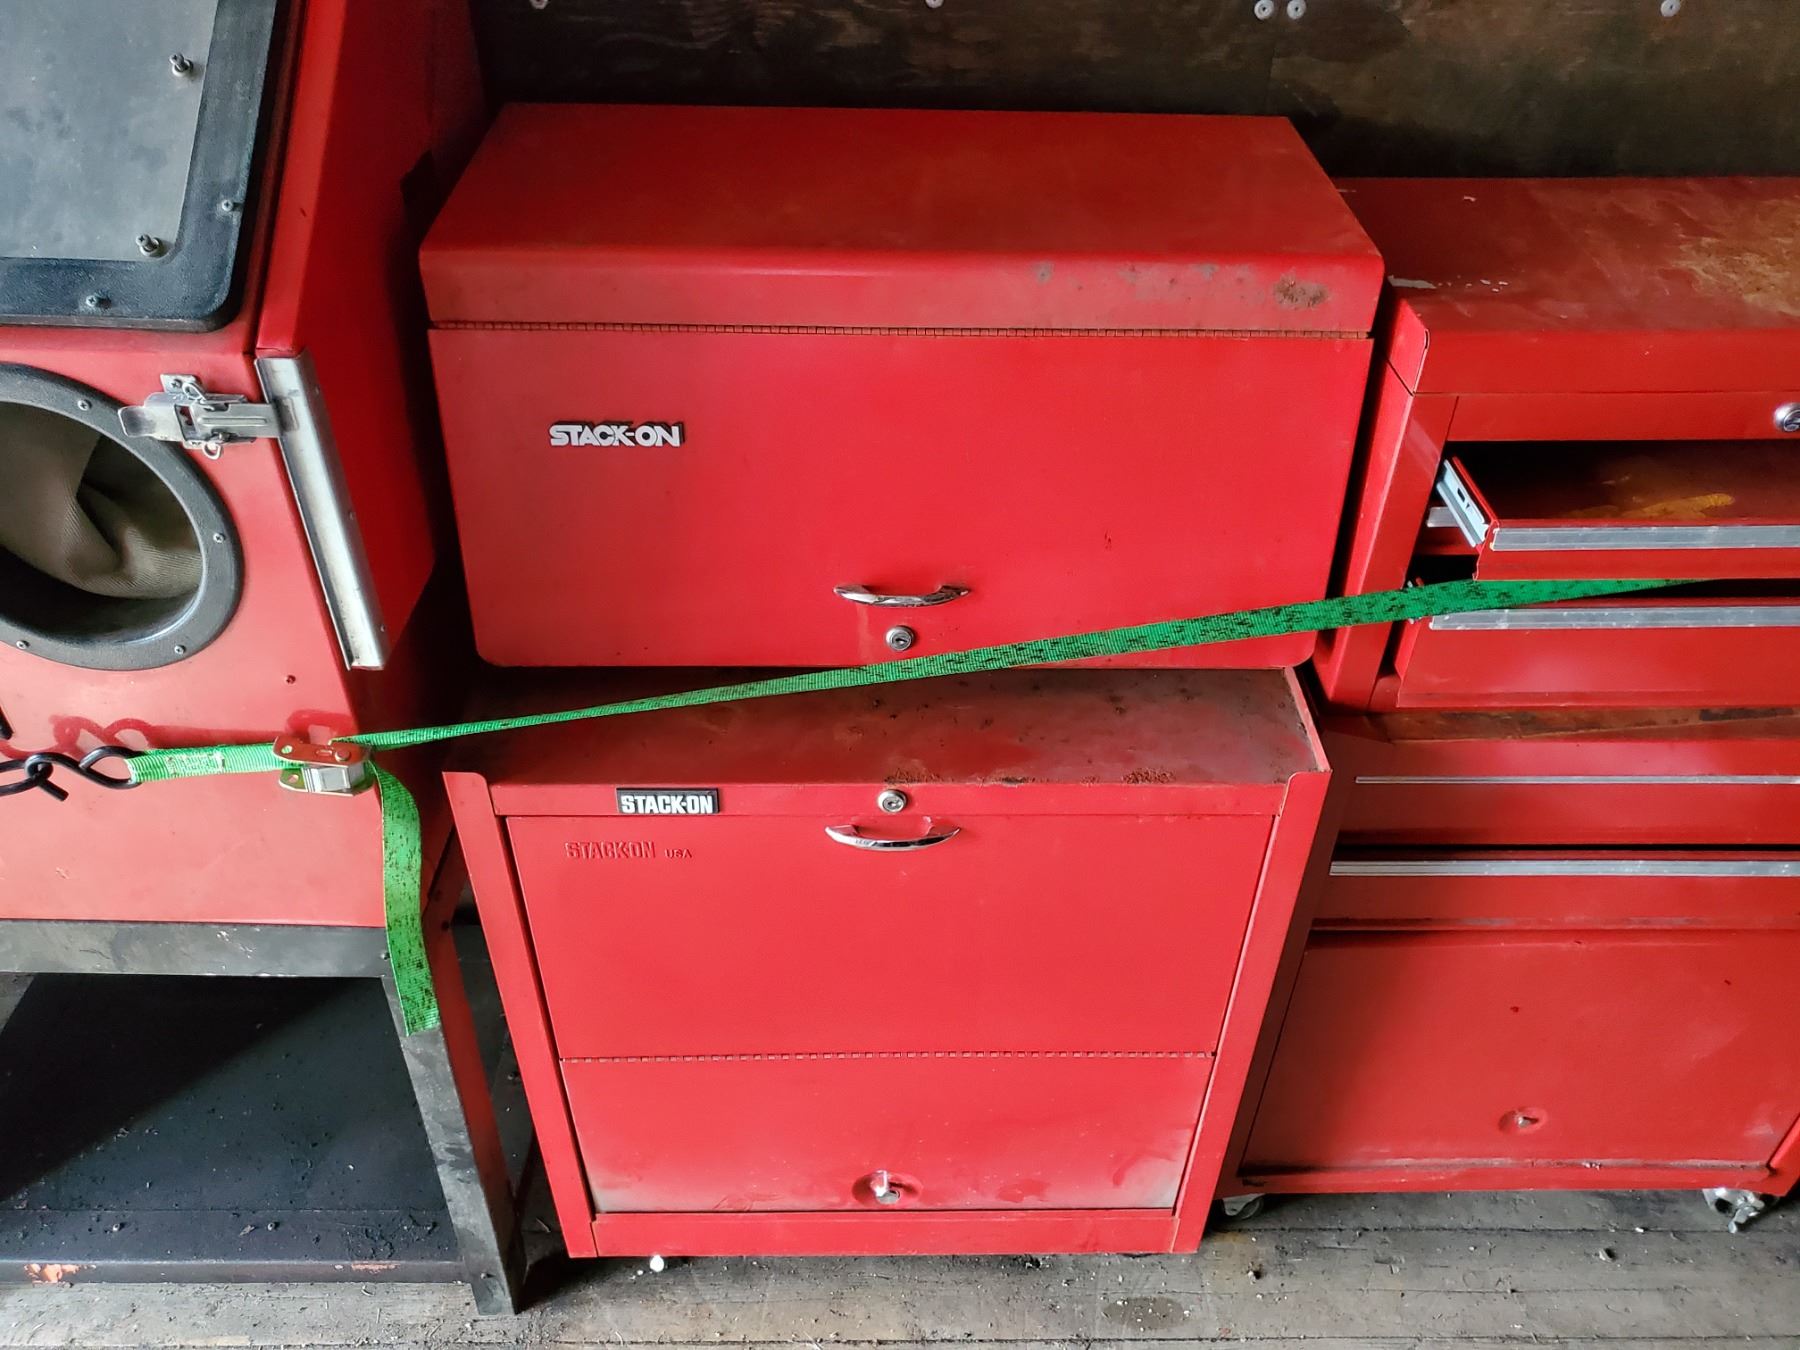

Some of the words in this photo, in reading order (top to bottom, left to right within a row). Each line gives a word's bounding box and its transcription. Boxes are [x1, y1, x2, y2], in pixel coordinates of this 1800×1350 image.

[549, 424, 681, 447] STACK-ON
[620, 795, 714, 814] STACK-ON
[664, 848, 693, 858] USA
